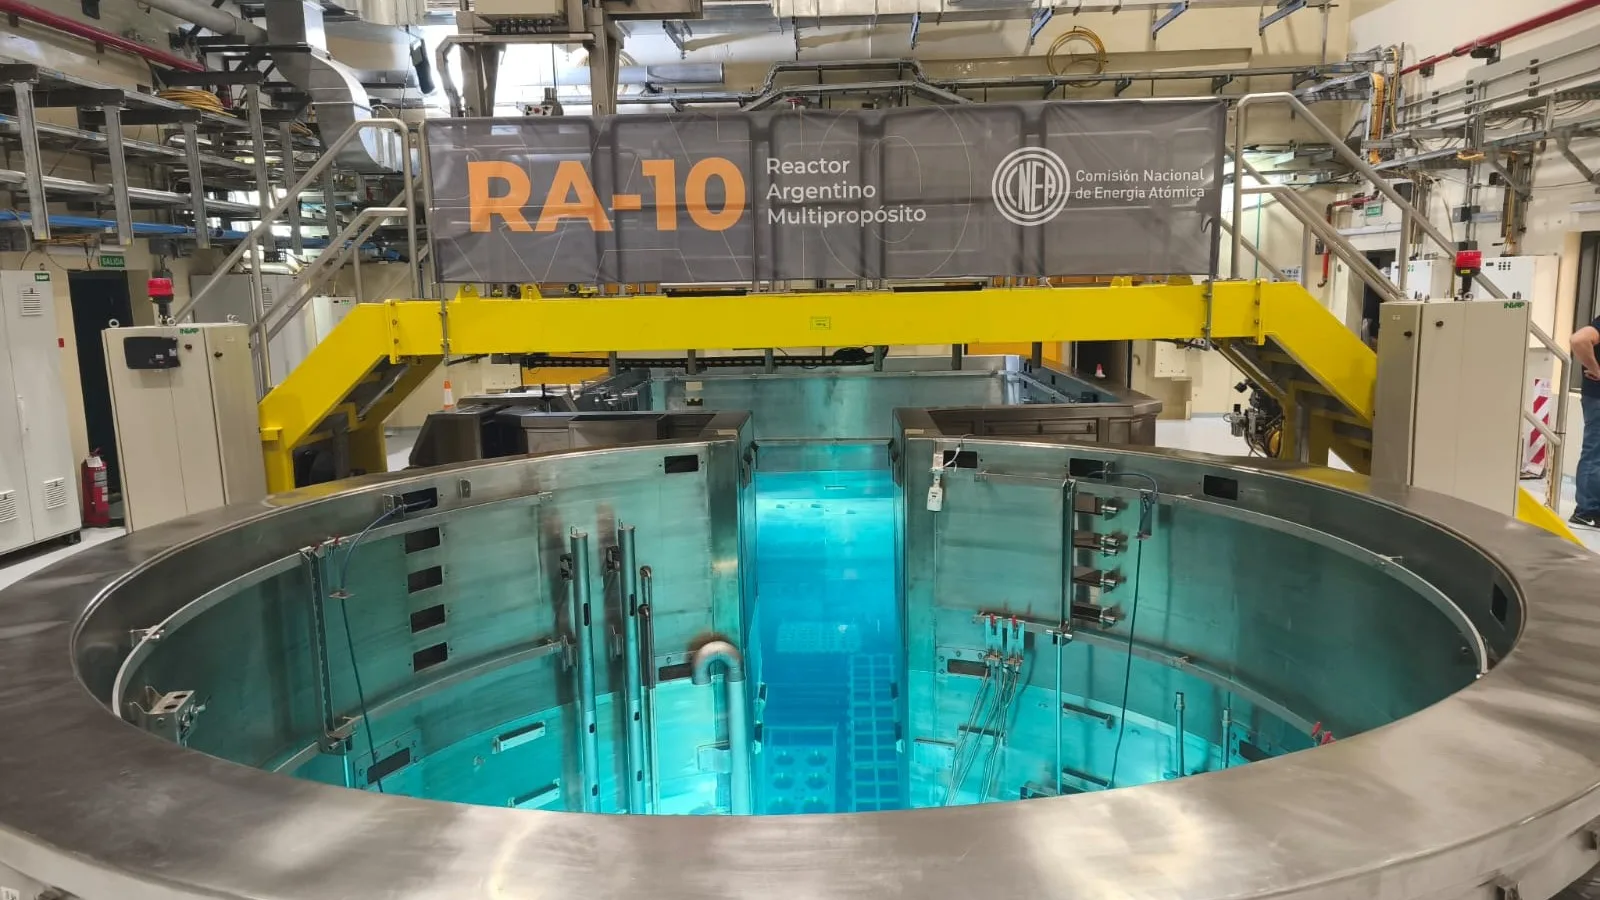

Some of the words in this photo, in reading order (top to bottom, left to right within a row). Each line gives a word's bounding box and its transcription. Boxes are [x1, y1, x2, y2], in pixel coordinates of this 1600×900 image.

[766, 157, 850, 175] Reactor
[1076, 169, 1139, 182] Comisión
[1143, 168, 1205, 181] Nacional
[467, 157, 746, 232] RA-10
[766, 181, 877, 203] Argentino
[1075, 187, 1091, 199] de
[1149, 184, 1205, 198] Atómica
[767, 206, 927, 226] Multipropósito
